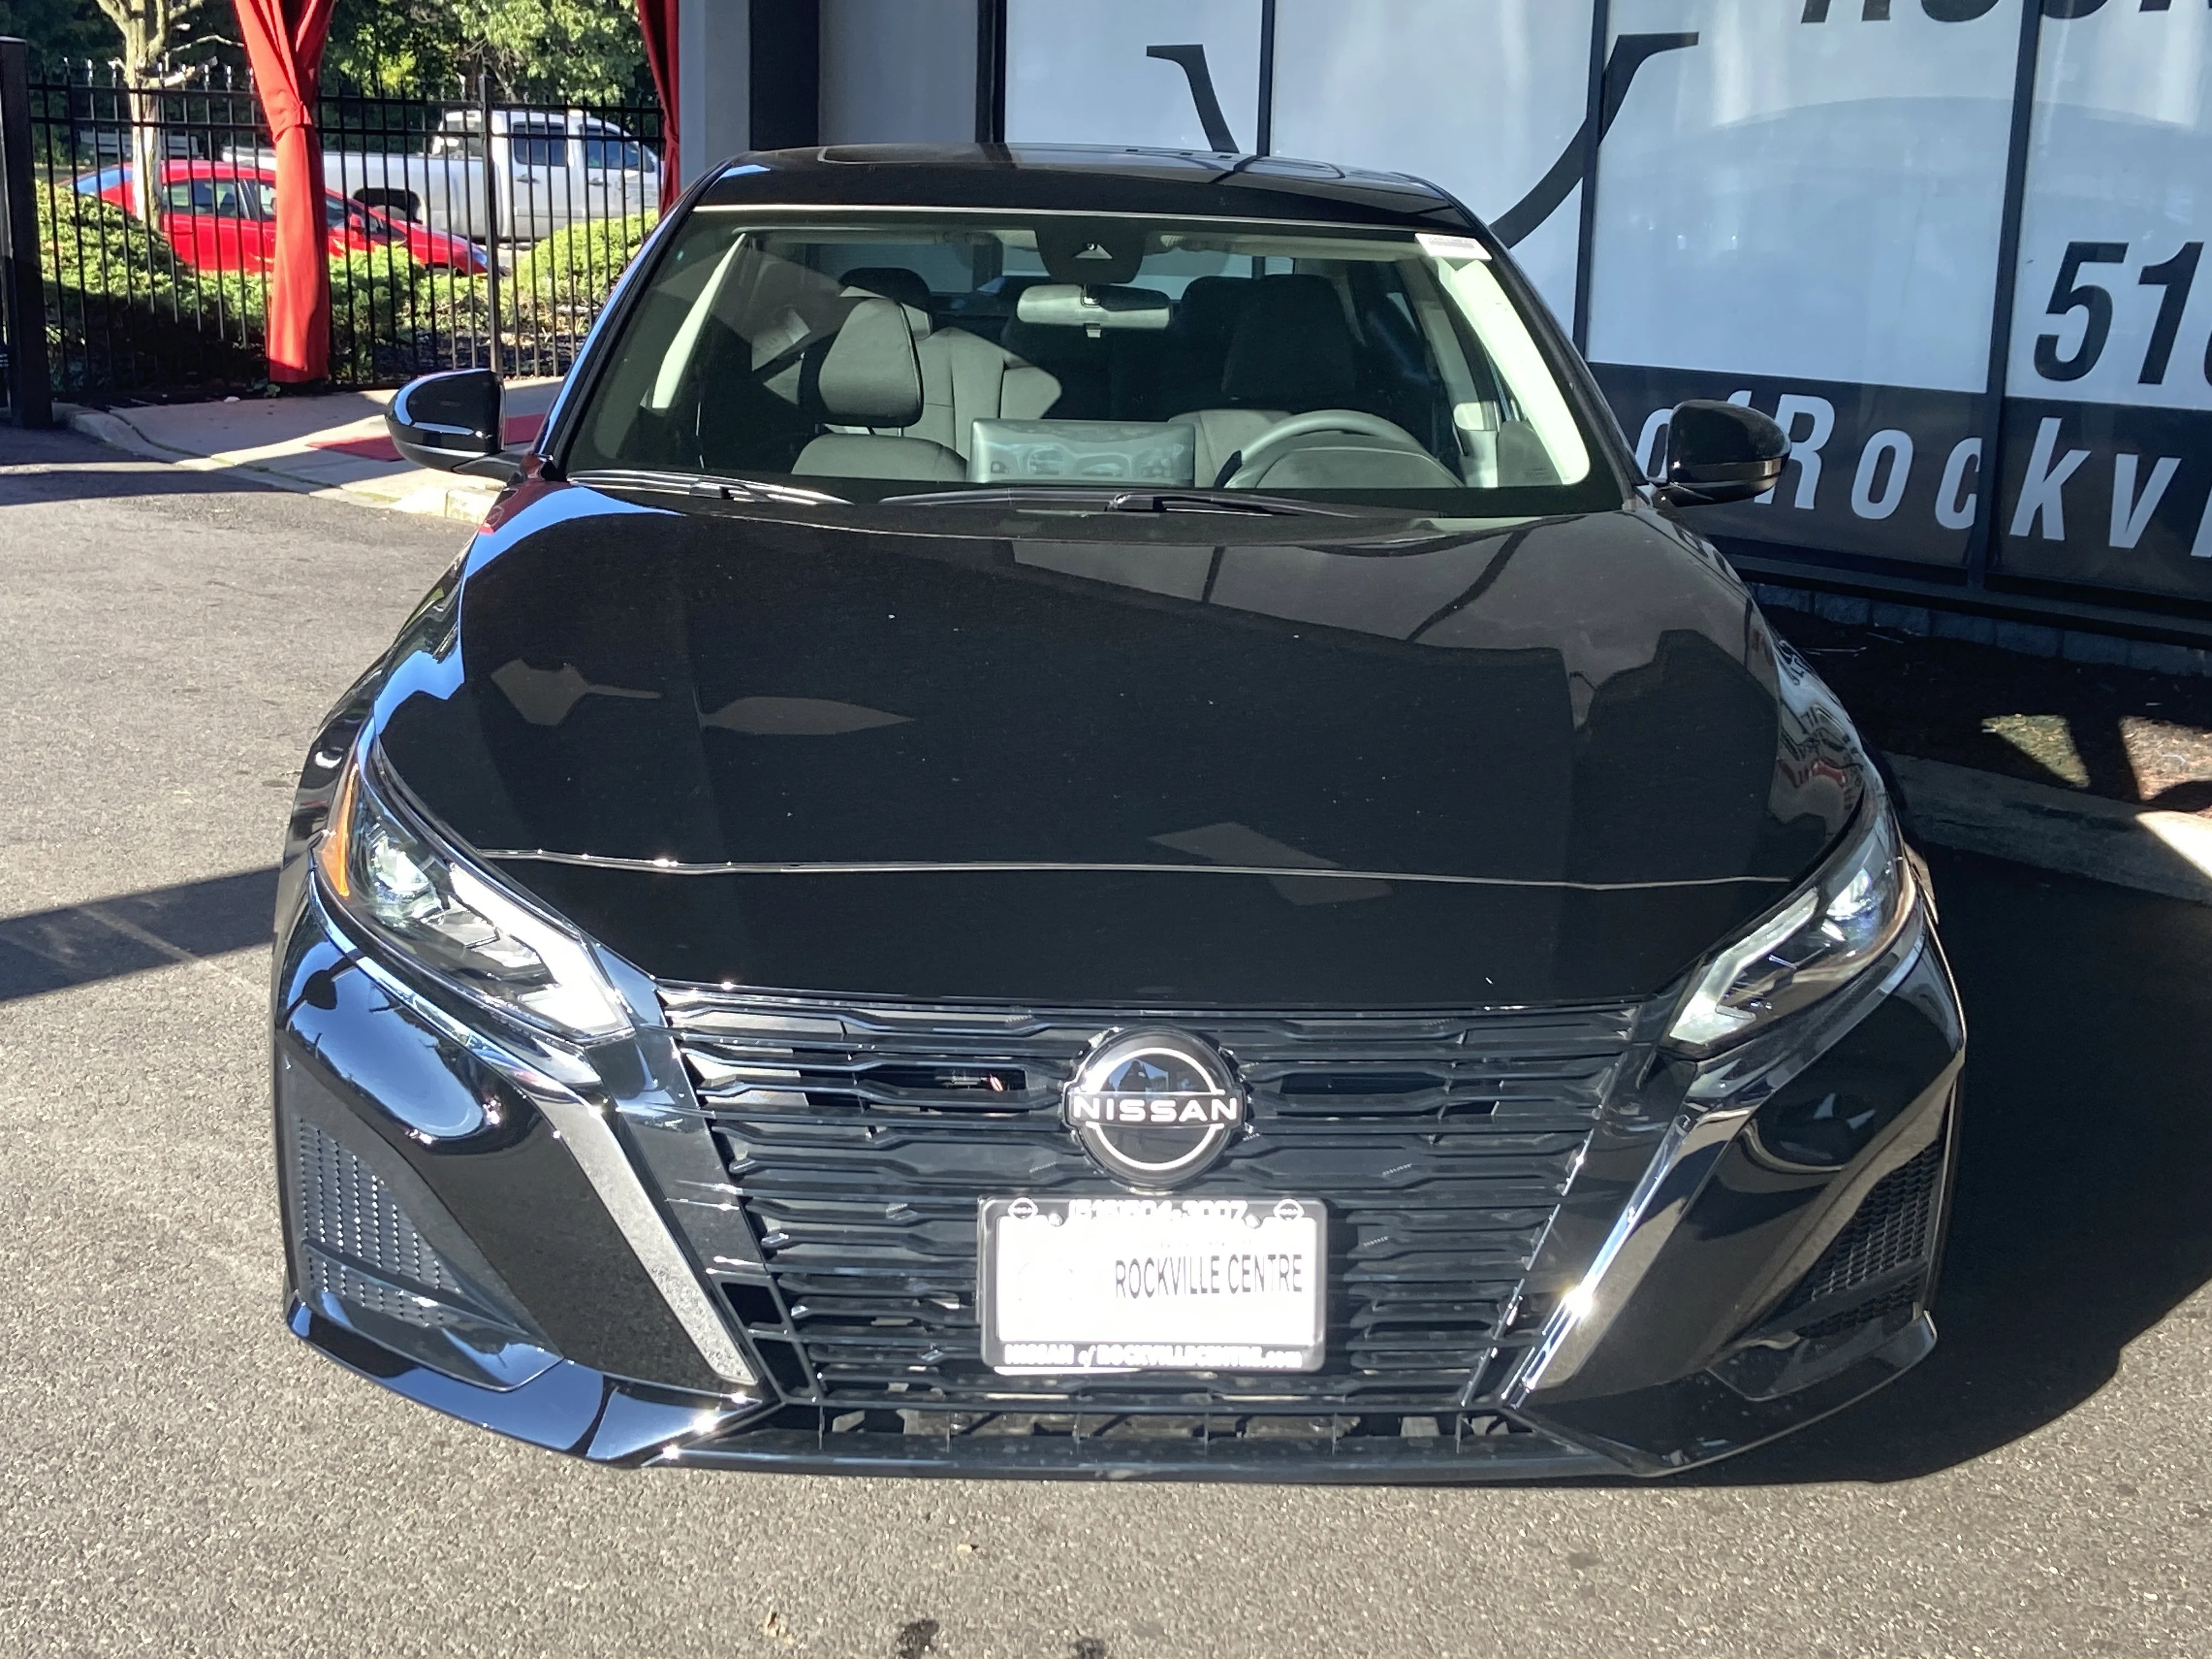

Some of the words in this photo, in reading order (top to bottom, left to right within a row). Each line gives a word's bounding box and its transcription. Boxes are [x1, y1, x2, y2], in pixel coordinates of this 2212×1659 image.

[2034, 241, 2212, 387] 51
[1073, 1097, 1237, 1122] NISSAN
[1115, 1256, 1220, 1299] ROCKVILLE
[1228, 1254, 1302, 1295] CENTRE
